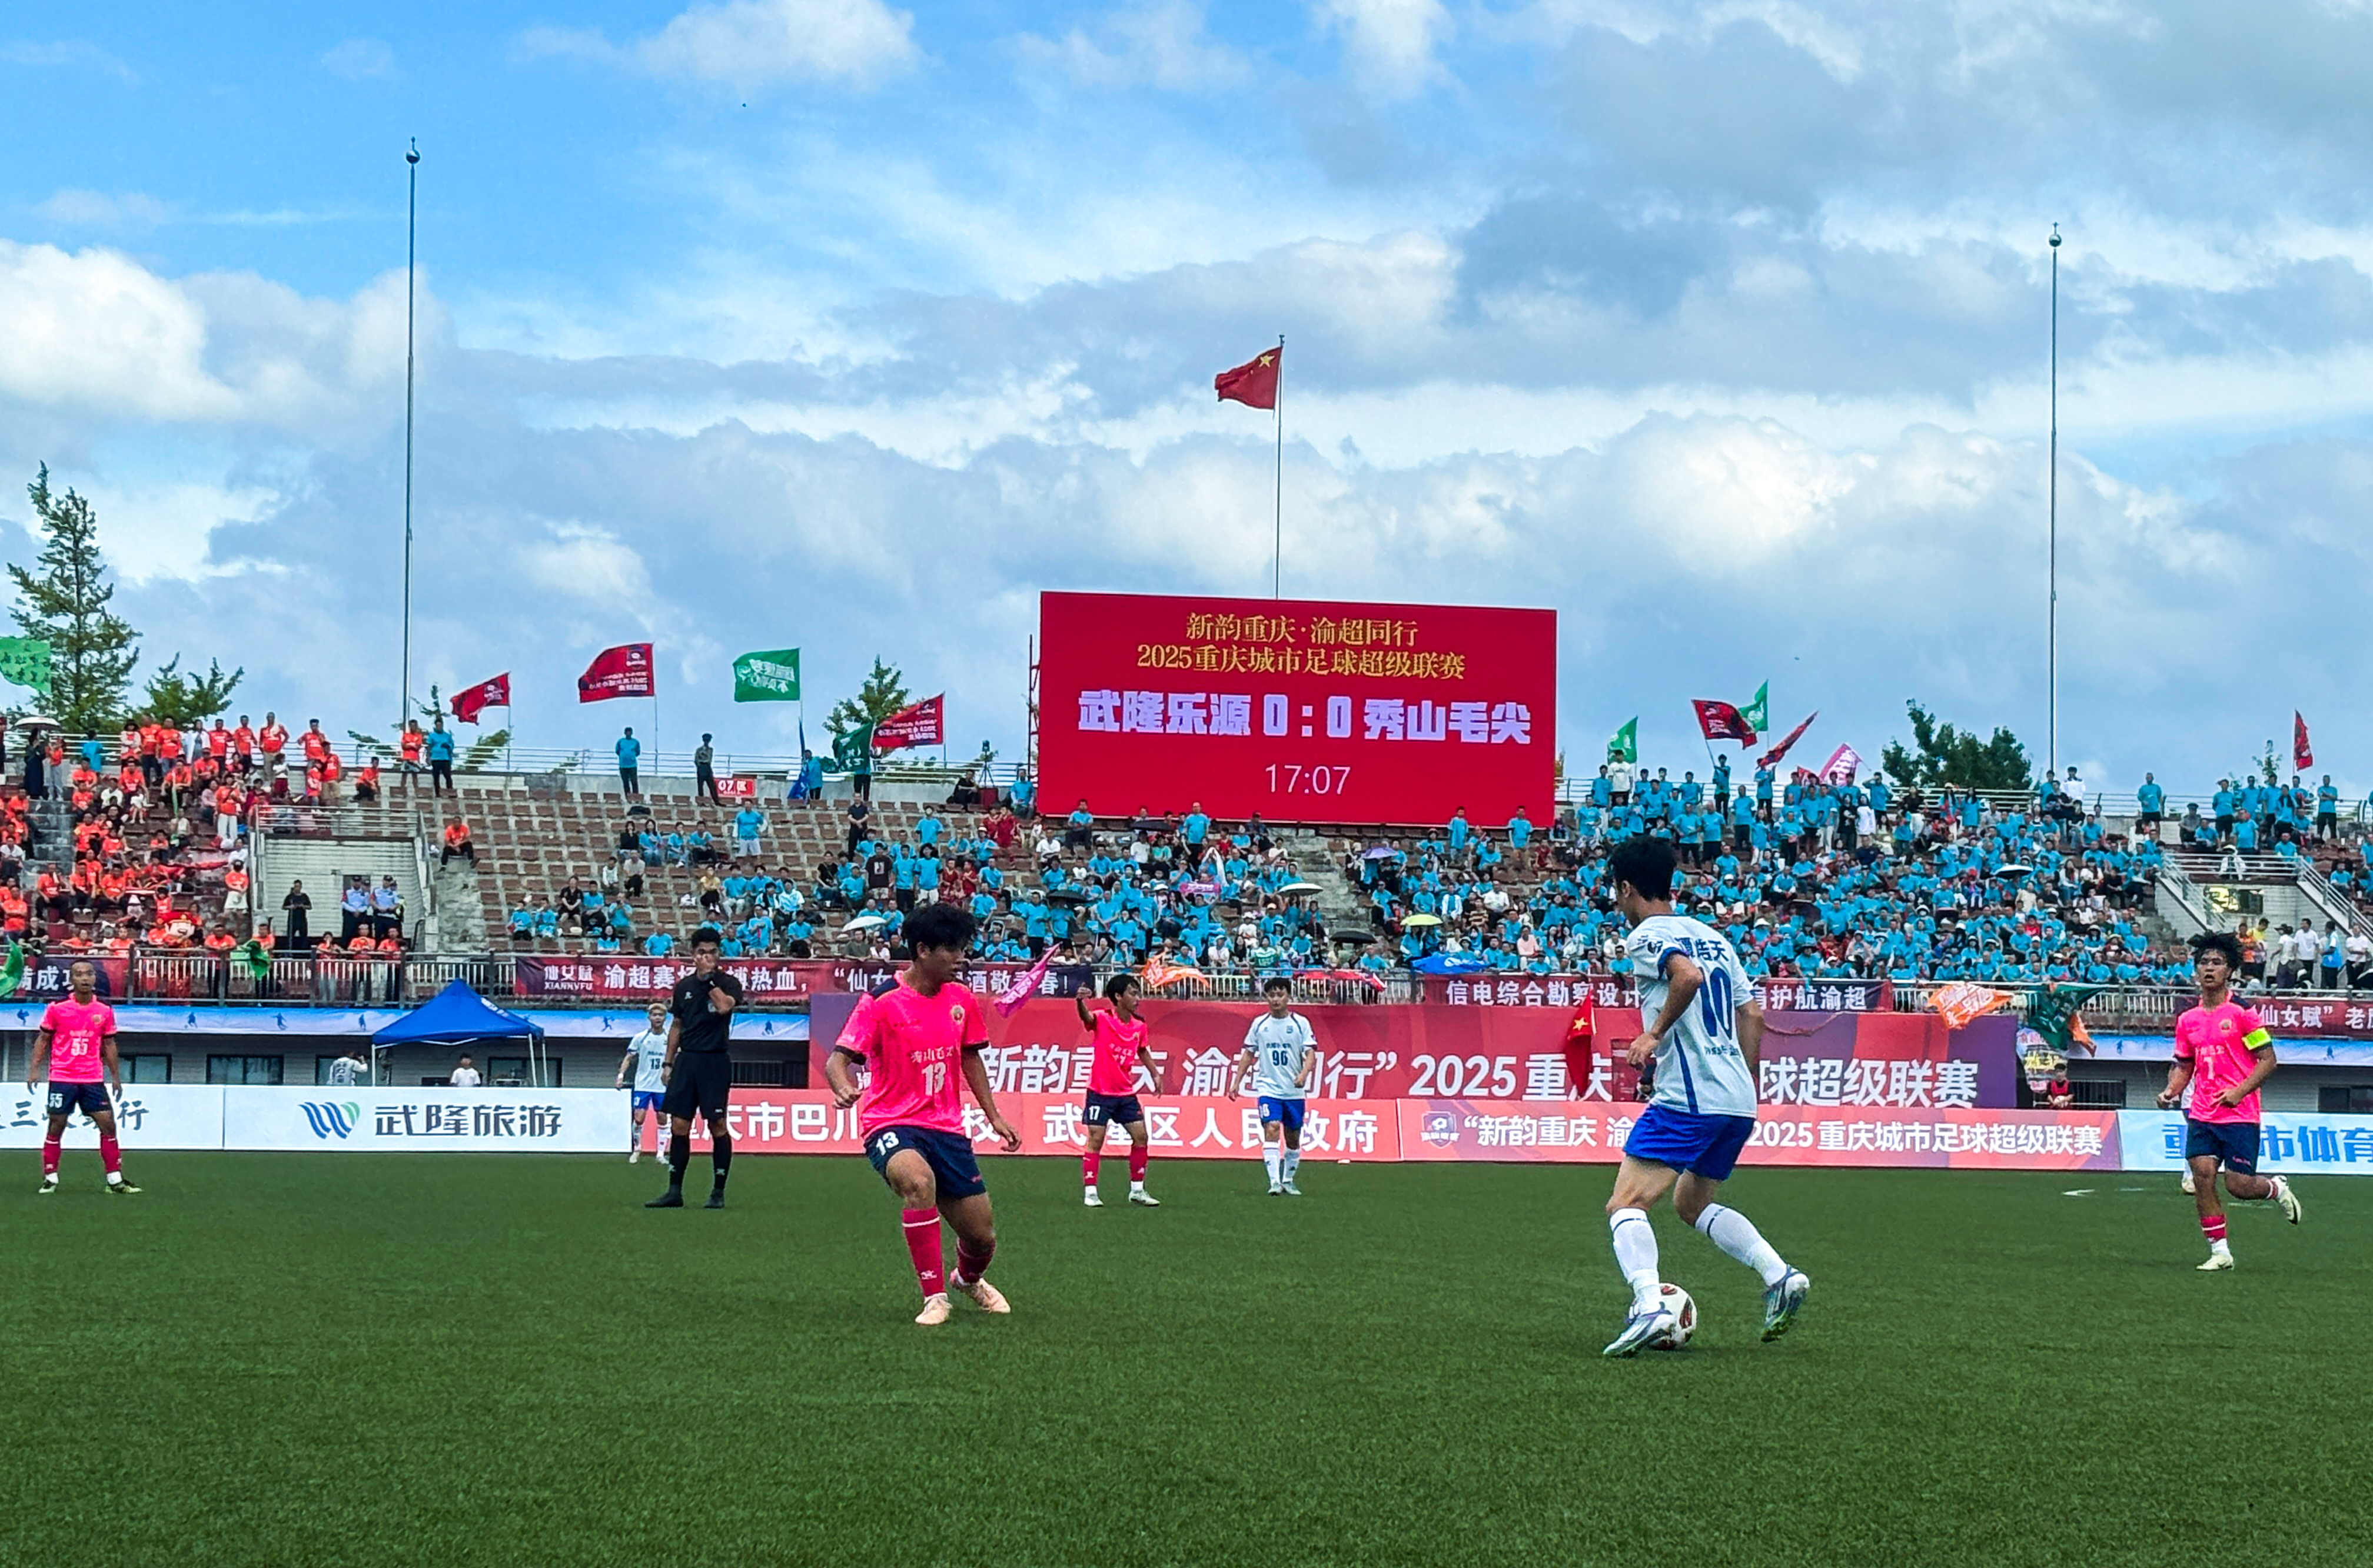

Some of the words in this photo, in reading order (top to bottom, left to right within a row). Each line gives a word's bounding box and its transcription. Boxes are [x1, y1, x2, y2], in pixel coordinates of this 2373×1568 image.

[1185, 612, 1419, 647] 新韵重庆·渝超同行
[1136, 645, 1465, 680] 2025重庆城市足球超级联赛
[1078, 690, 1251, 736] 武隆乐源
[1364, 699, 1531, 744] 秀山毛尖
[1264, 763, 1351, 795] 17:07
[1698, 966, 1733, 1041] 10
[71, 1038, 88, 1057] 55
[922, 1061, 946, 1097] 13
[375, 1105, 562, 1137] 武隆旅游
[1089, 1105, 1100, 1120] 17
[876, 1132, 899, 1155] 13
